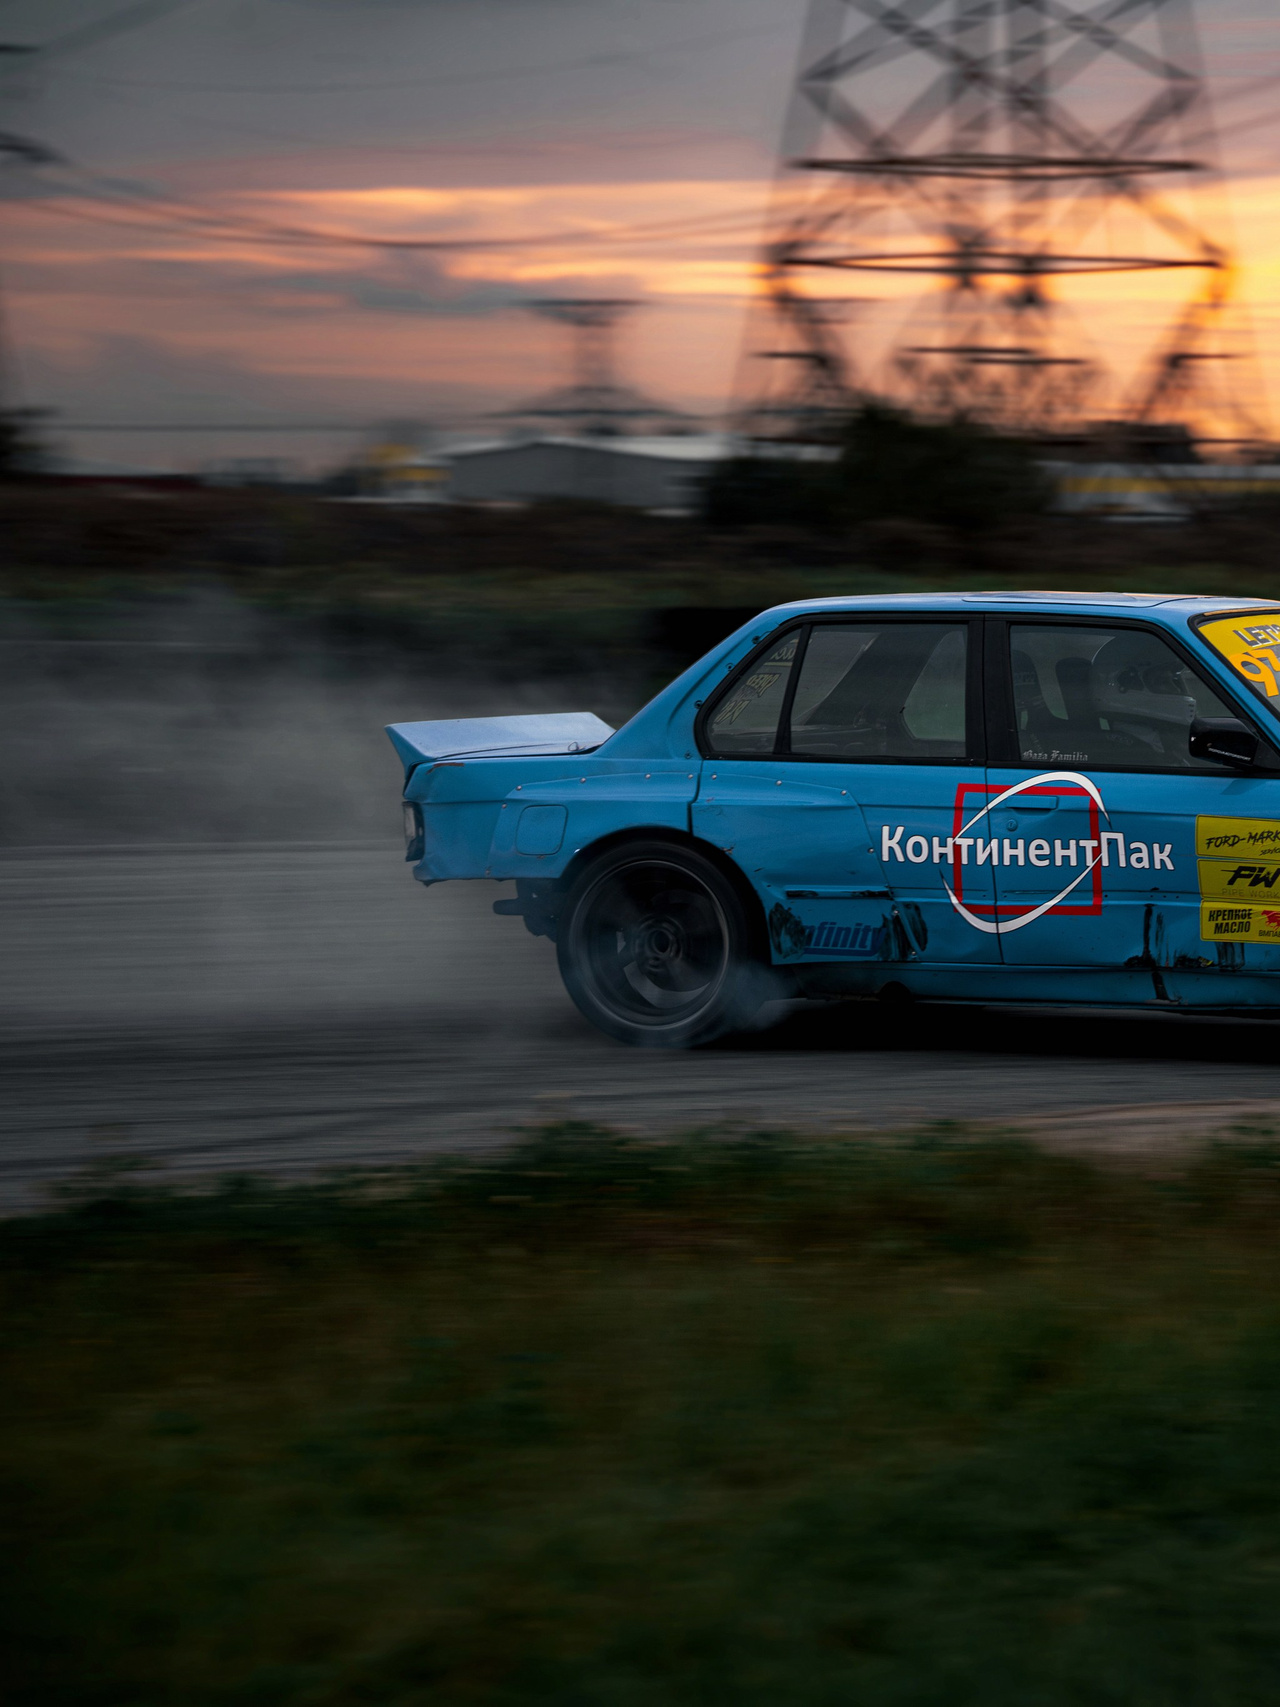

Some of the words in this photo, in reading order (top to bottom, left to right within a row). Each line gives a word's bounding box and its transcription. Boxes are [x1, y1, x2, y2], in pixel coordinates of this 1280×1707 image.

[1049, 750, 1089, 762] Familia
[880, 825, 1175, 871] КонтинентПак
[1221, 888, 1244, 897] PIPE
[1208, 908, 1253, 922] КРЕПКОЕ
[1213, 921, 1251, 935] МАСЛО
